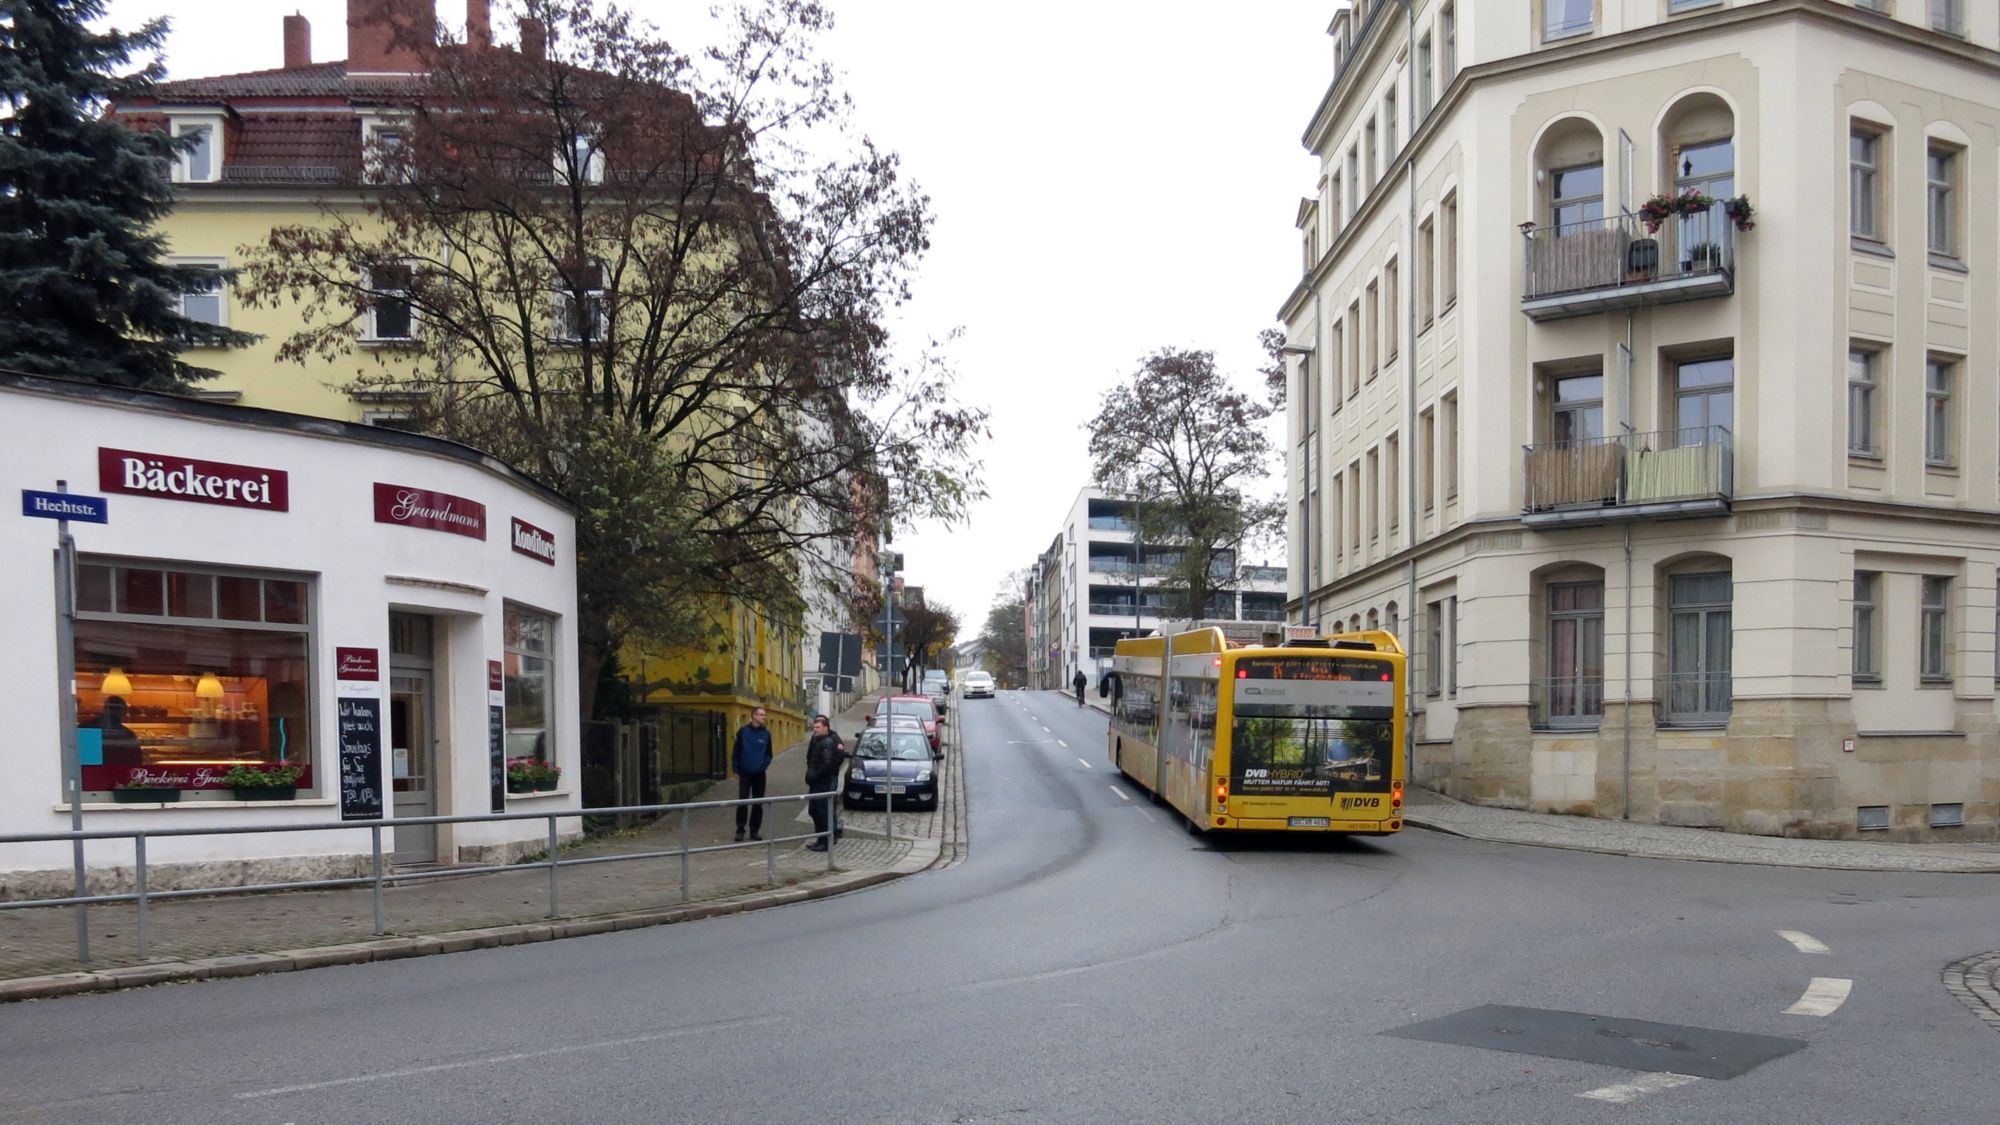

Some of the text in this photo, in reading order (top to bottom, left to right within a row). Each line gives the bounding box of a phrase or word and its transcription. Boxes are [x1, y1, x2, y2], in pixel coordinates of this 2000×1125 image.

[122, 457, 272, 504] Bäckerei
[34, 497, 97, 516] Hechtstr.
[391, 489, 480, 529] Grundmann
[339, 664, 377, 673] Grundmann
[339, 702, 373, 717] Wir haben
[130, 768, 189, 785] Bäckerei
[1245, 769, 1304, 778] DVB HYBRID
[1353, 797, 1380, 807] DVB
